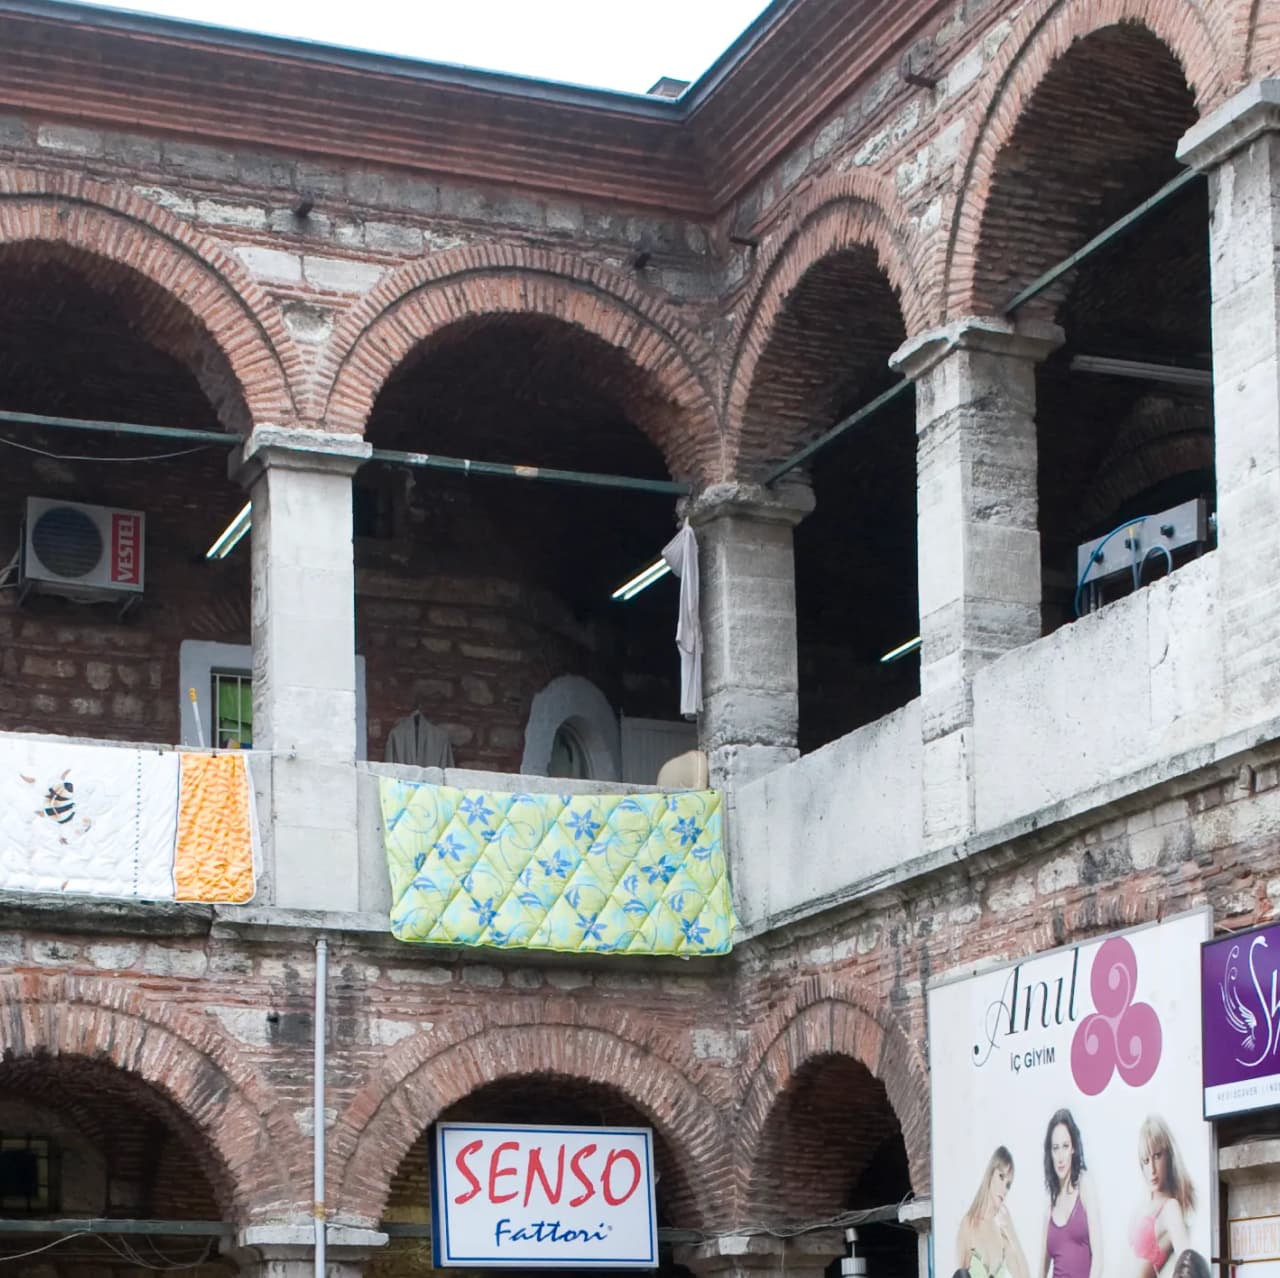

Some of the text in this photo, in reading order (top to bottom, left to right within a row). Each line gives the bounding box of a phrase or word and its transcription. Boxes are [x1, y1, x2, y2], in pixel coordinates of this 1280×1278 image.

[117, 517, 135, 581] VESTEL
[1010, 1046, 1055, 1075] İÇ GİYİM
[454, 1139, 642, 1208] SENSO
[494, 1218, 609, 1247] Fattori
